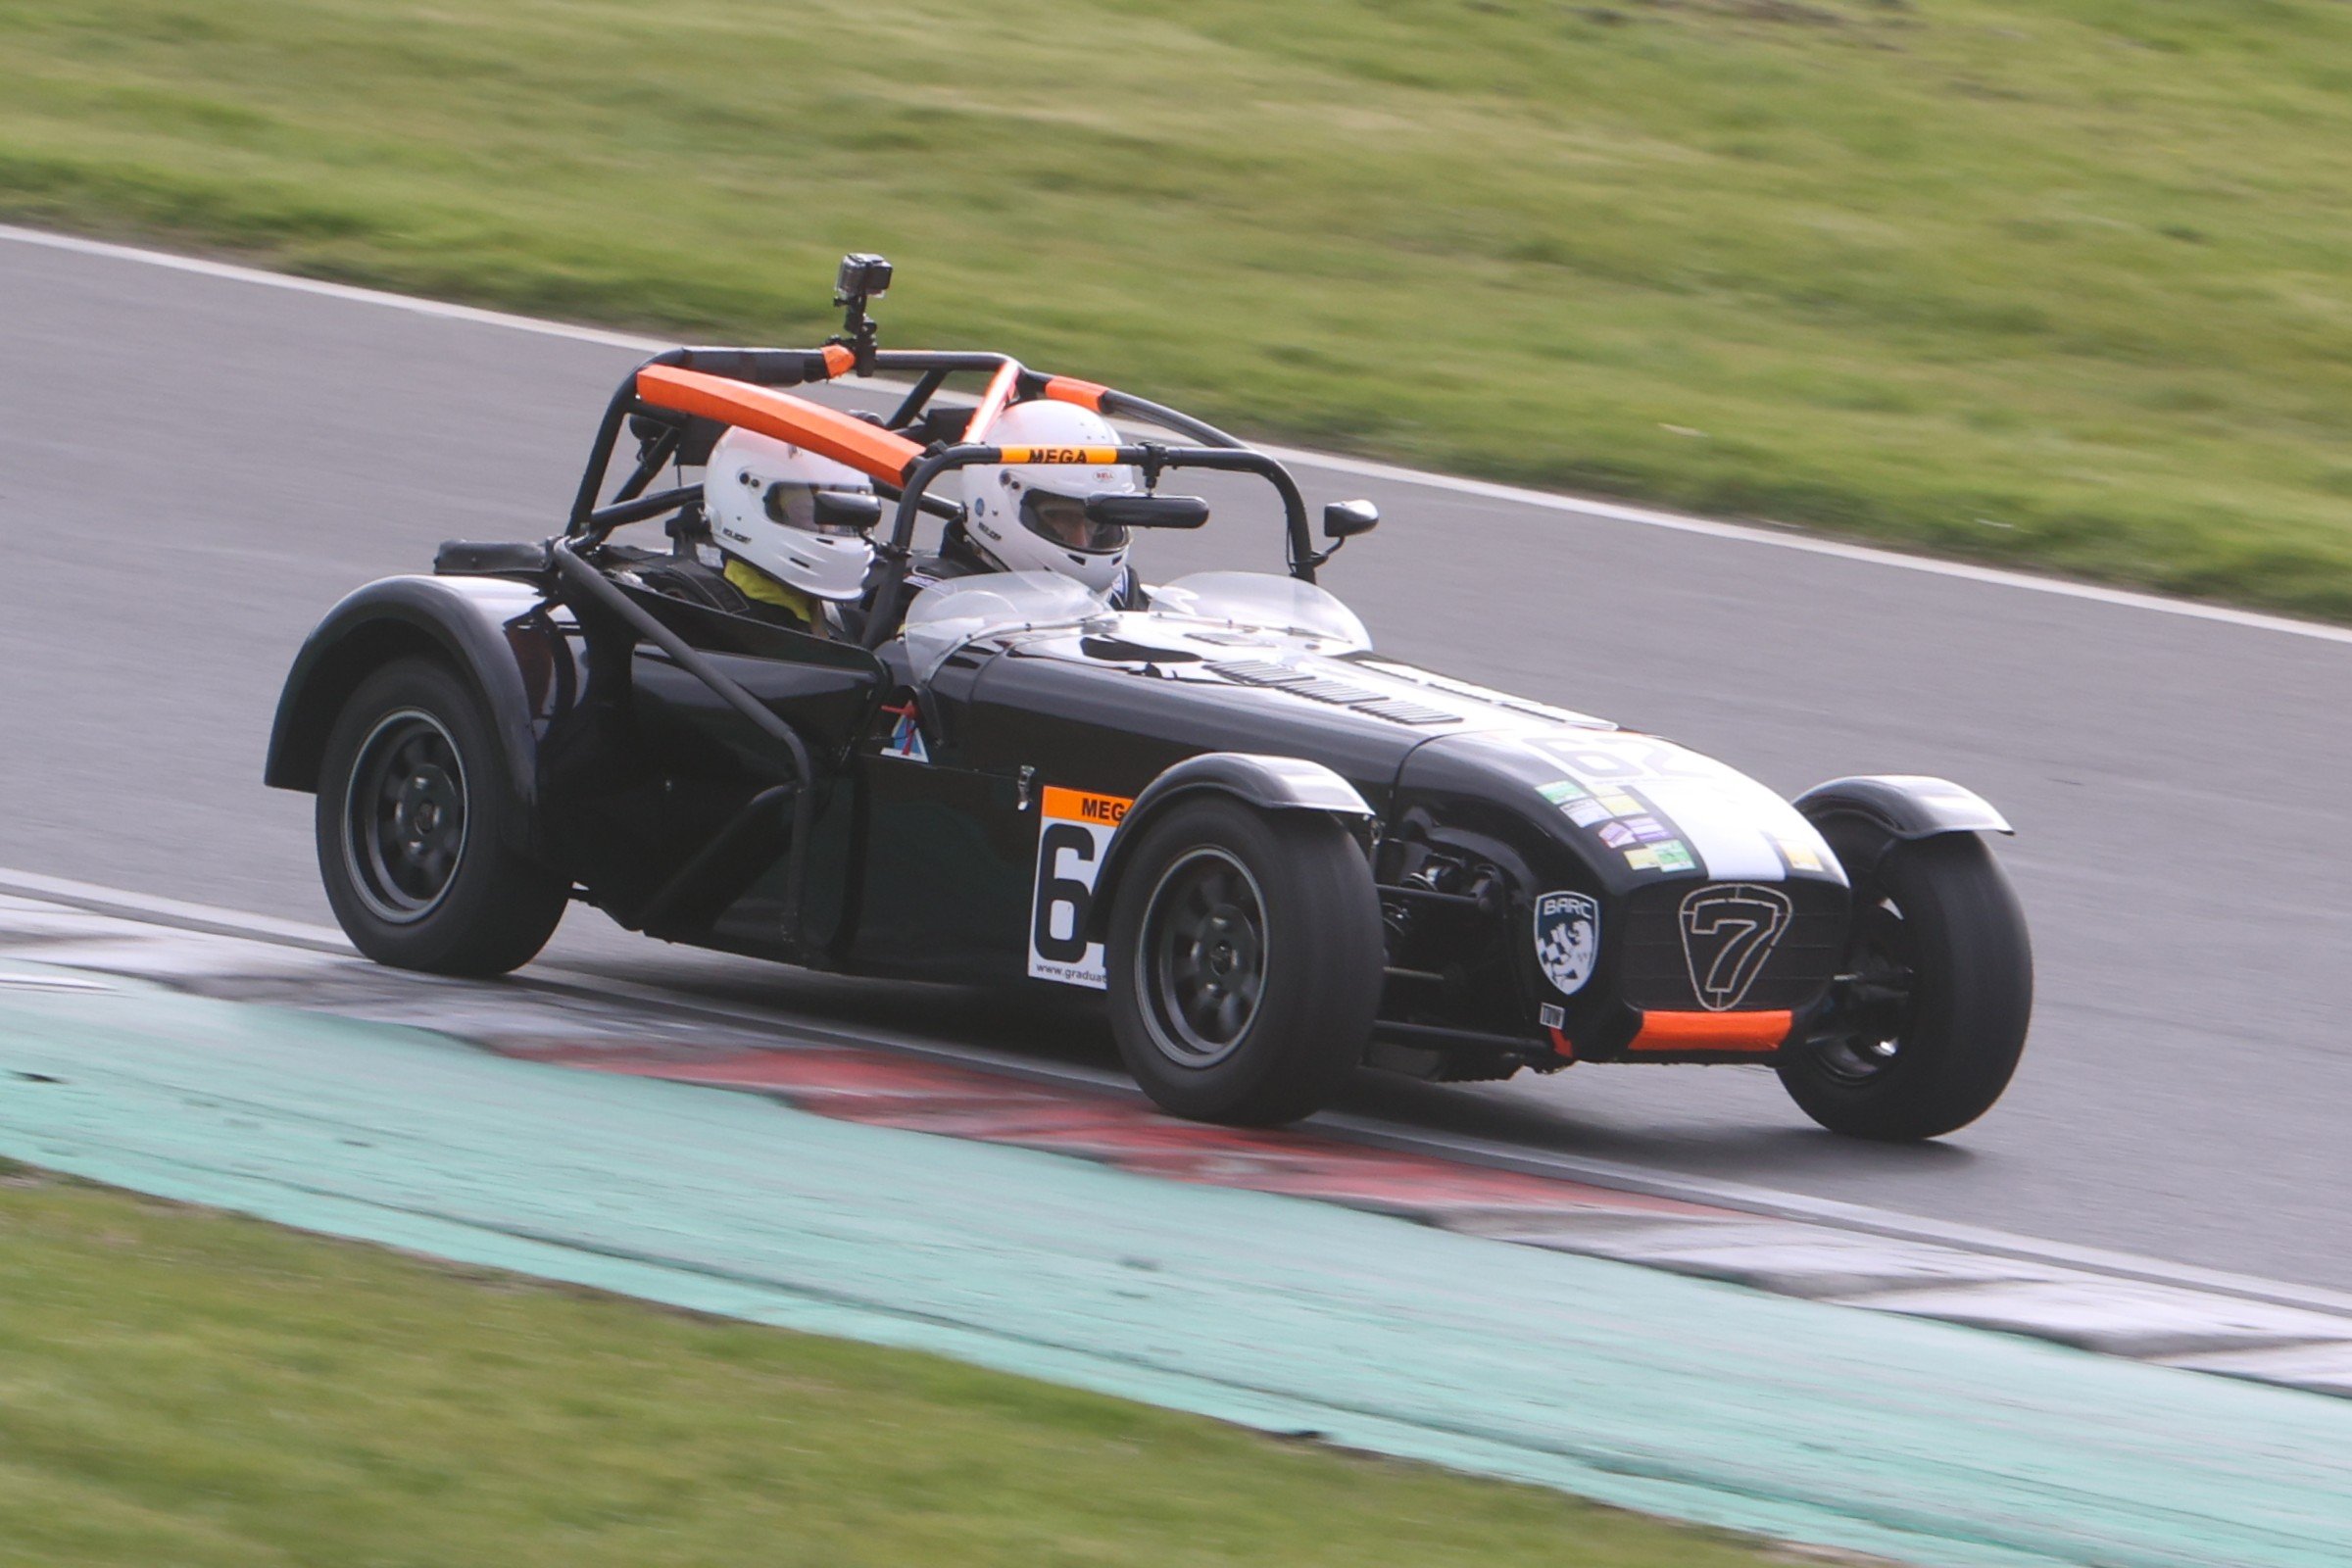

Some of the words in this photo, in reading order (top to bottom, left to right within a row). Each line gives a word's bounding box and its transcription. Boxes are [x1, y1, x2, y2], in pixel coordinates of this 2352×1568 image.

[1027, 448, 1088, 465] MEGA
[1521, 737, 1715, 779] 62
[1081, 797, 1125, 822] MEG
[1034, 823, 1096, 963] 6
[1544, 898, 1593, 920] BARC
[1690, 898, 1779, 994] 7
[1036, 963, 1107, 984] www.graduat
